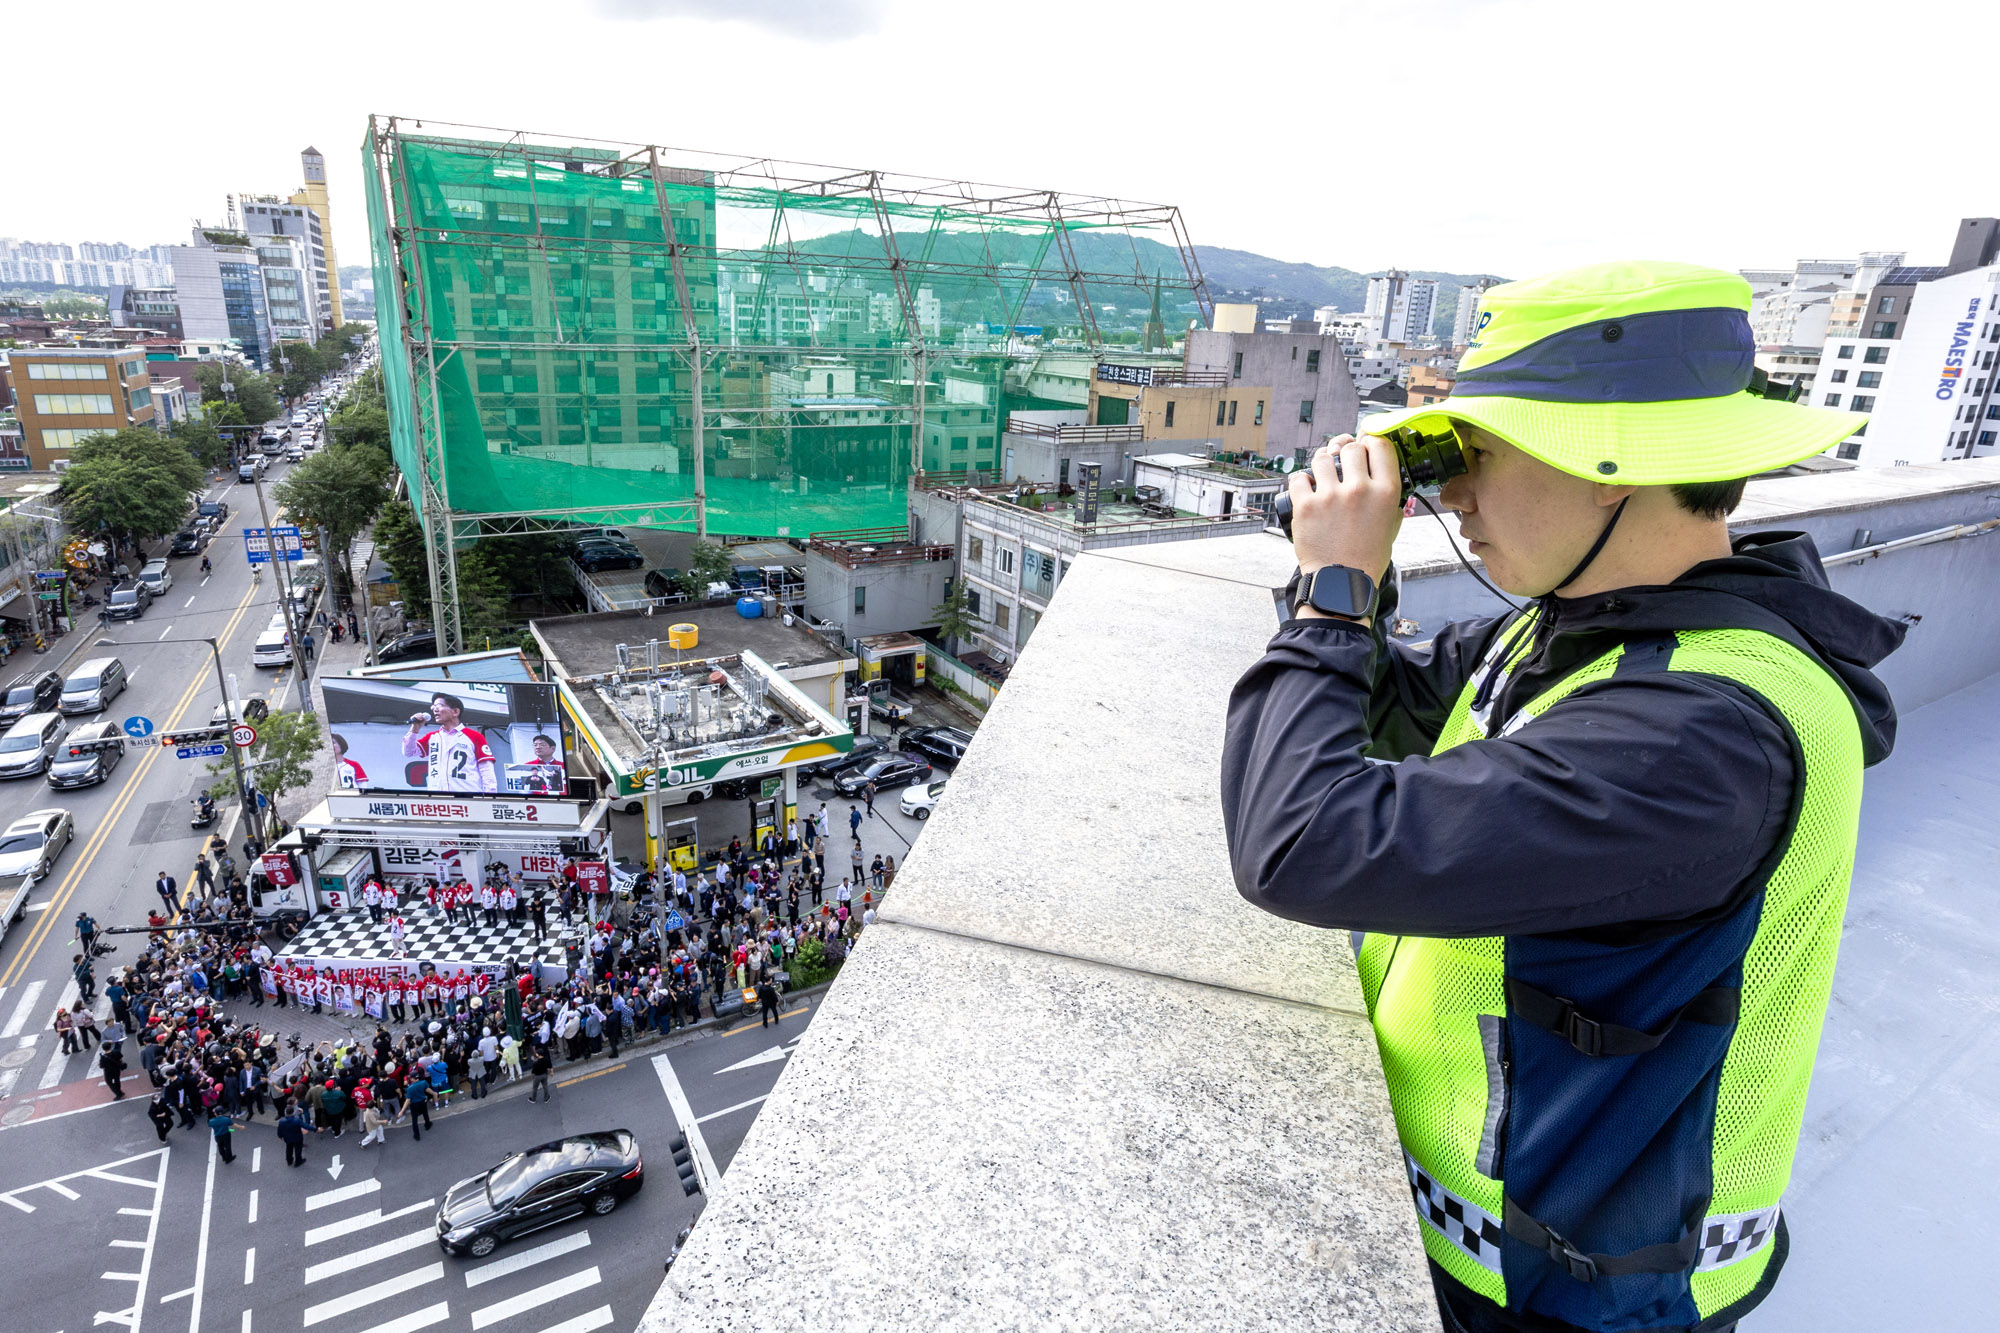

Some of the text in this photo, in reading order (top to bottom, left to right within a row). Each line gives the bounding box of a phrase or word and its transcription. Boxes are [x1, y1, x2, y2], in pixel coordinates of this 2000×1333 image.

[1936, 322, 1974, 401] MAESTRO
[1120, 368, 1137, 383] 스크린
[234, 730, 252, 741] 30
[430, 742, 439, 778] 김문수
[451, 750, 468, 780] 2
[735, 755, 769, 769] 에쓰-오일
[368, 803, 469, 818] 새롭게 대한민국!
[492, 804, 538, 821] 김문수 2
[274, 871, 287, 883] 2
[580, 869, 606, 879] 김문수
[588, 879, 599, 891] 2
[329, 892, 341, 908] 2
[299, 984, 310, 998] 2
[319, 982, 328, 997] 2
